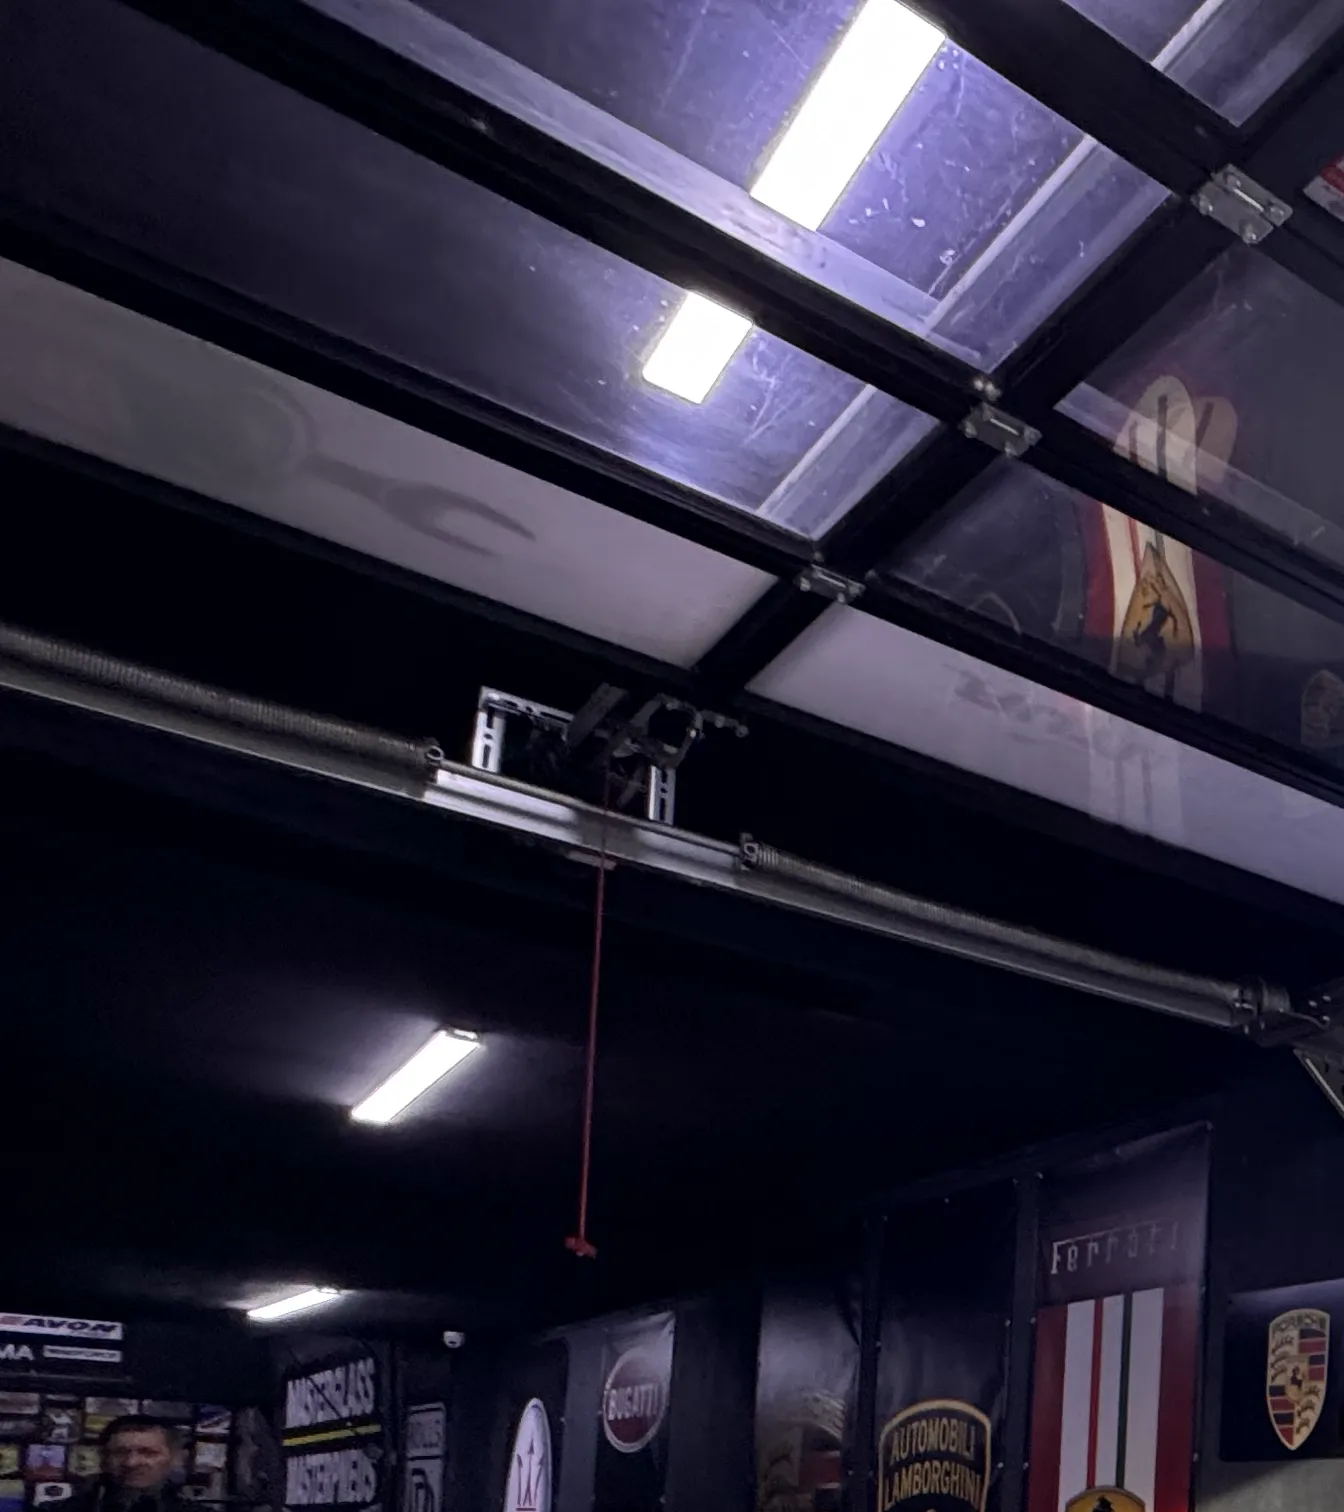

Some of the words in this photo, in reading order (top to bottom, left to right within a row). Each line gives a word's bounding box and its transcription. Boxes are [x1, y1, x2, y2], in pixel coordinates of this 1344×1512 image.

[23, 1318, 119, 1333] AVON
[607, 1383, 661, 1421] BUGATTI
[889, 1417, 976, 1467] AUTOMOBILI
[884, 1460, 982, 1512] LAMBORGHINI
